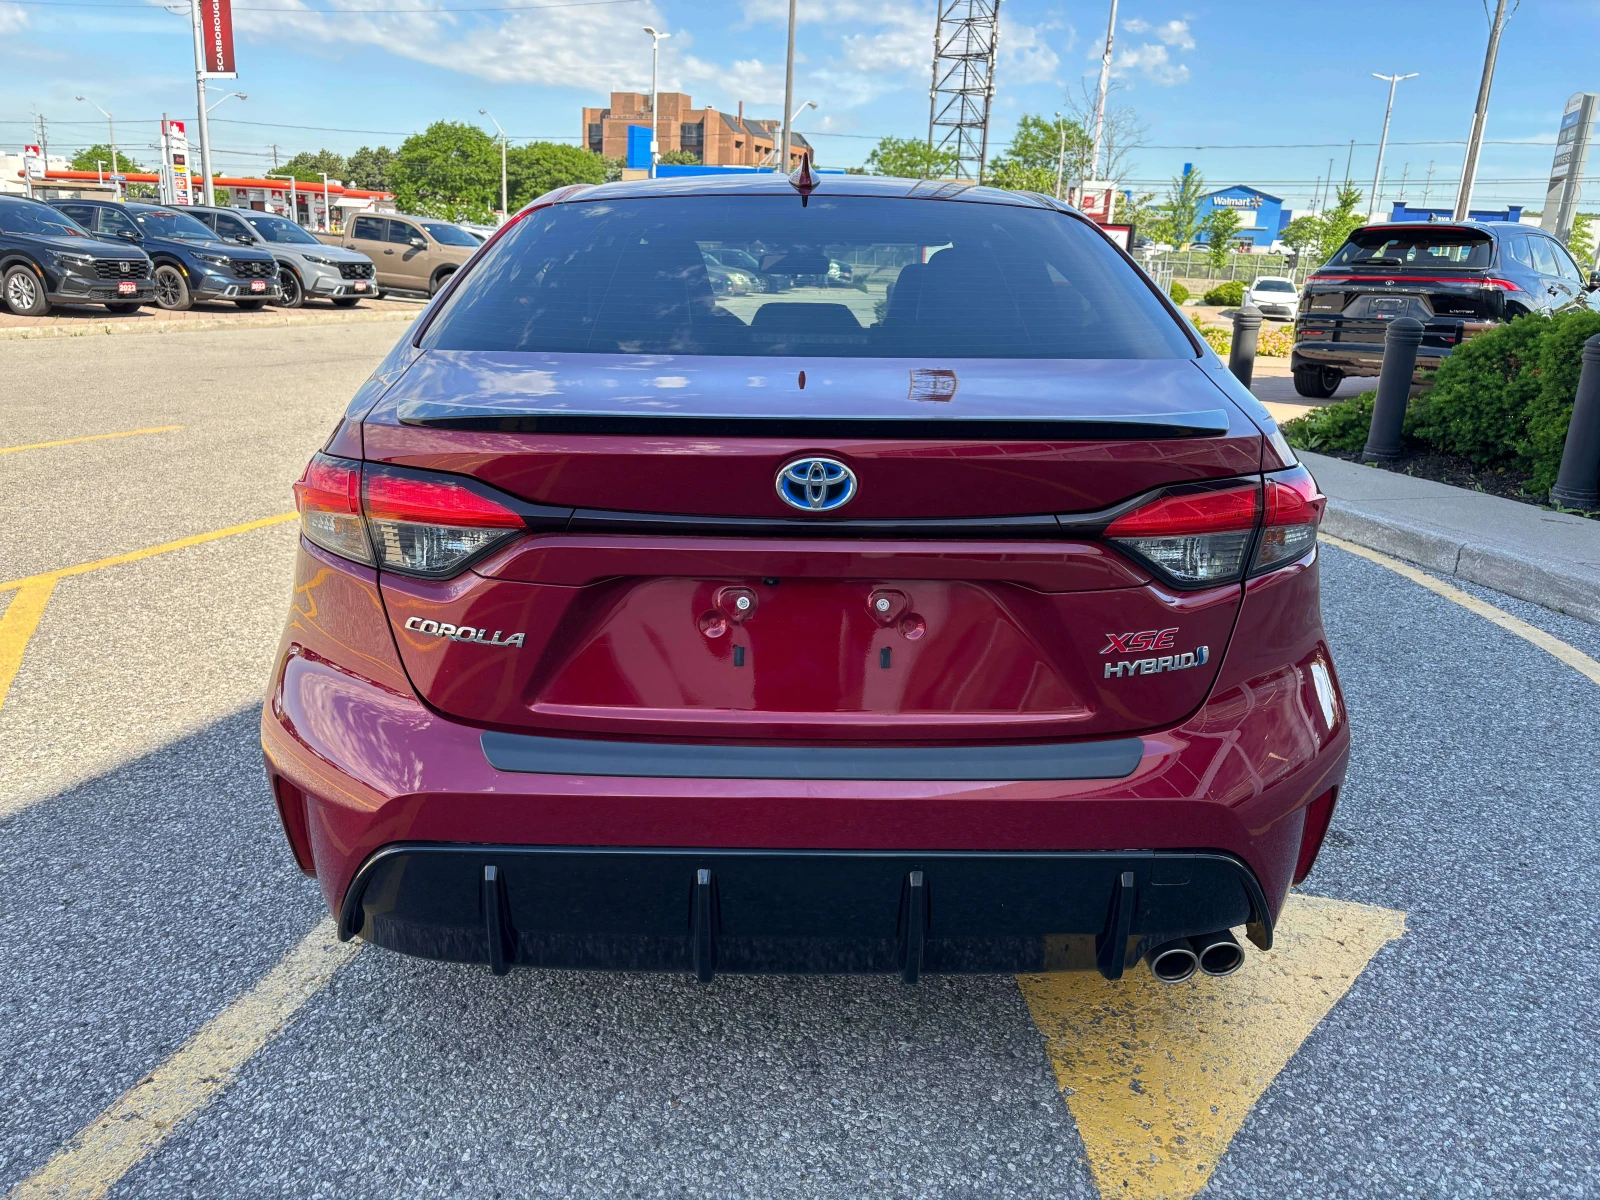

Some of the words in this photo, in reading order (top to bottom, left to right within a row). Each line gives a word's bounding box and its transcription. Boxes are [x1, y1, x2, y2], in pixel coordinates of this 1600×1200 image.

[1213, 196, 1251, 206] Walmart
[404, 616, 526, 648] COROLLA
[1099, 627, 1179, 654] XSE
[1104, 652, 1195, 678] HYBRID
